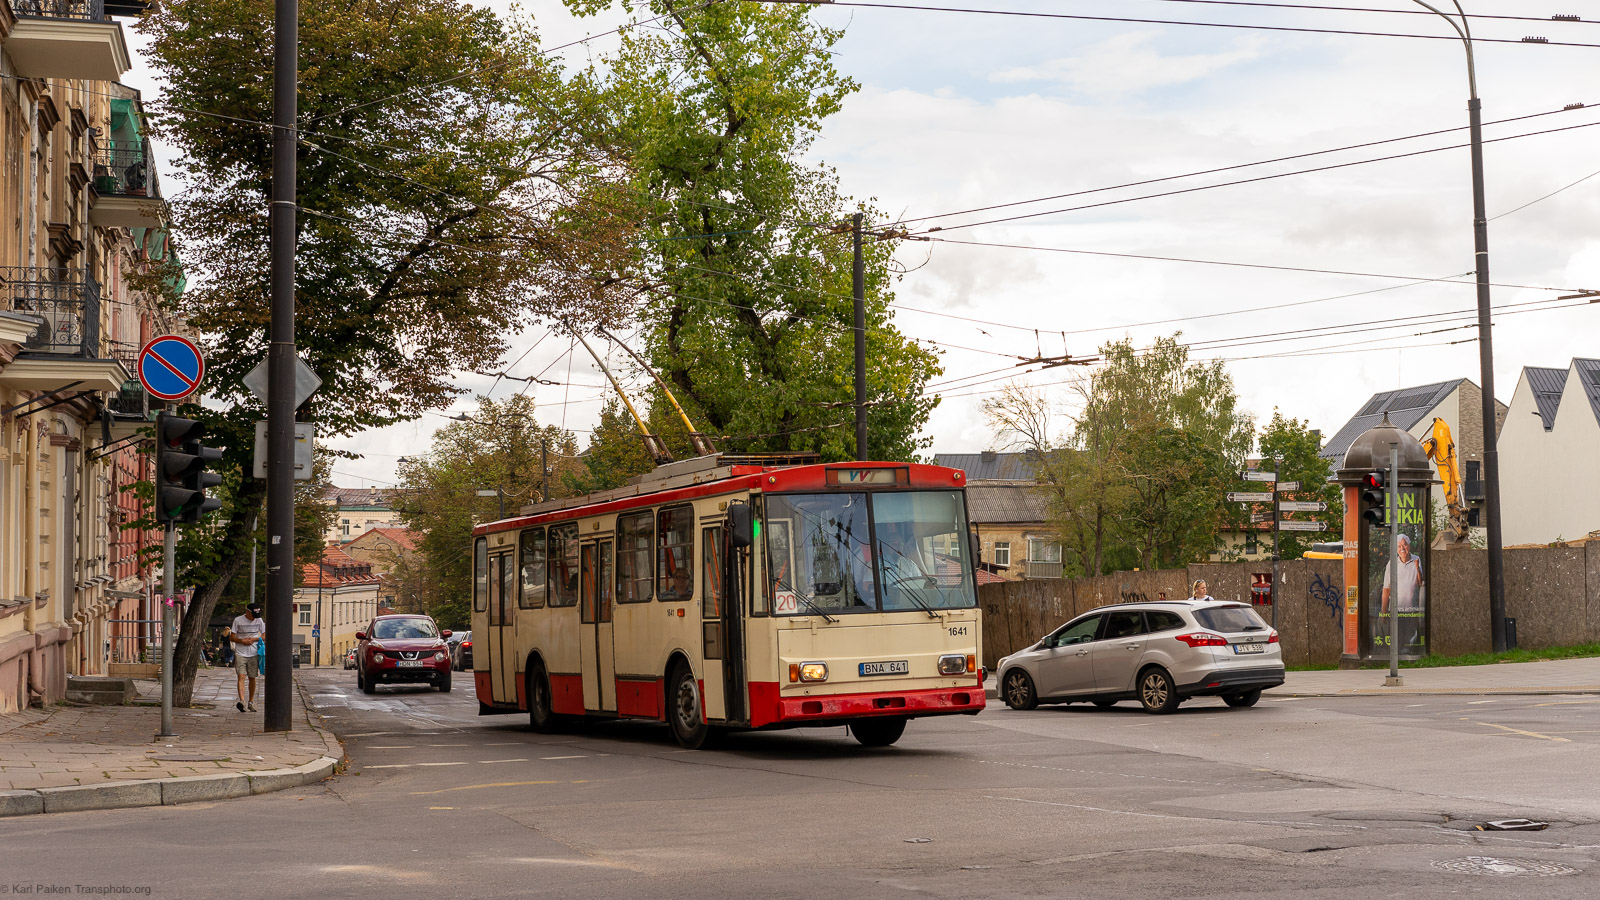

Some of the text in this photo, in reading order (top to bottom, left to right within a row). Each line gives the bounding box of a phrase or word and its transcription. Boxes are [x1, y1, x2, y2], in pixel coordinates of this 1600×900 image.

[849, 470, 881, 482] VVT
[777, 594, 797, 611] 20
[667, 608, 675, 617] 1641
[948, 627, 967, 636] 1641
[865, 662, 906, 673] BNA 641
